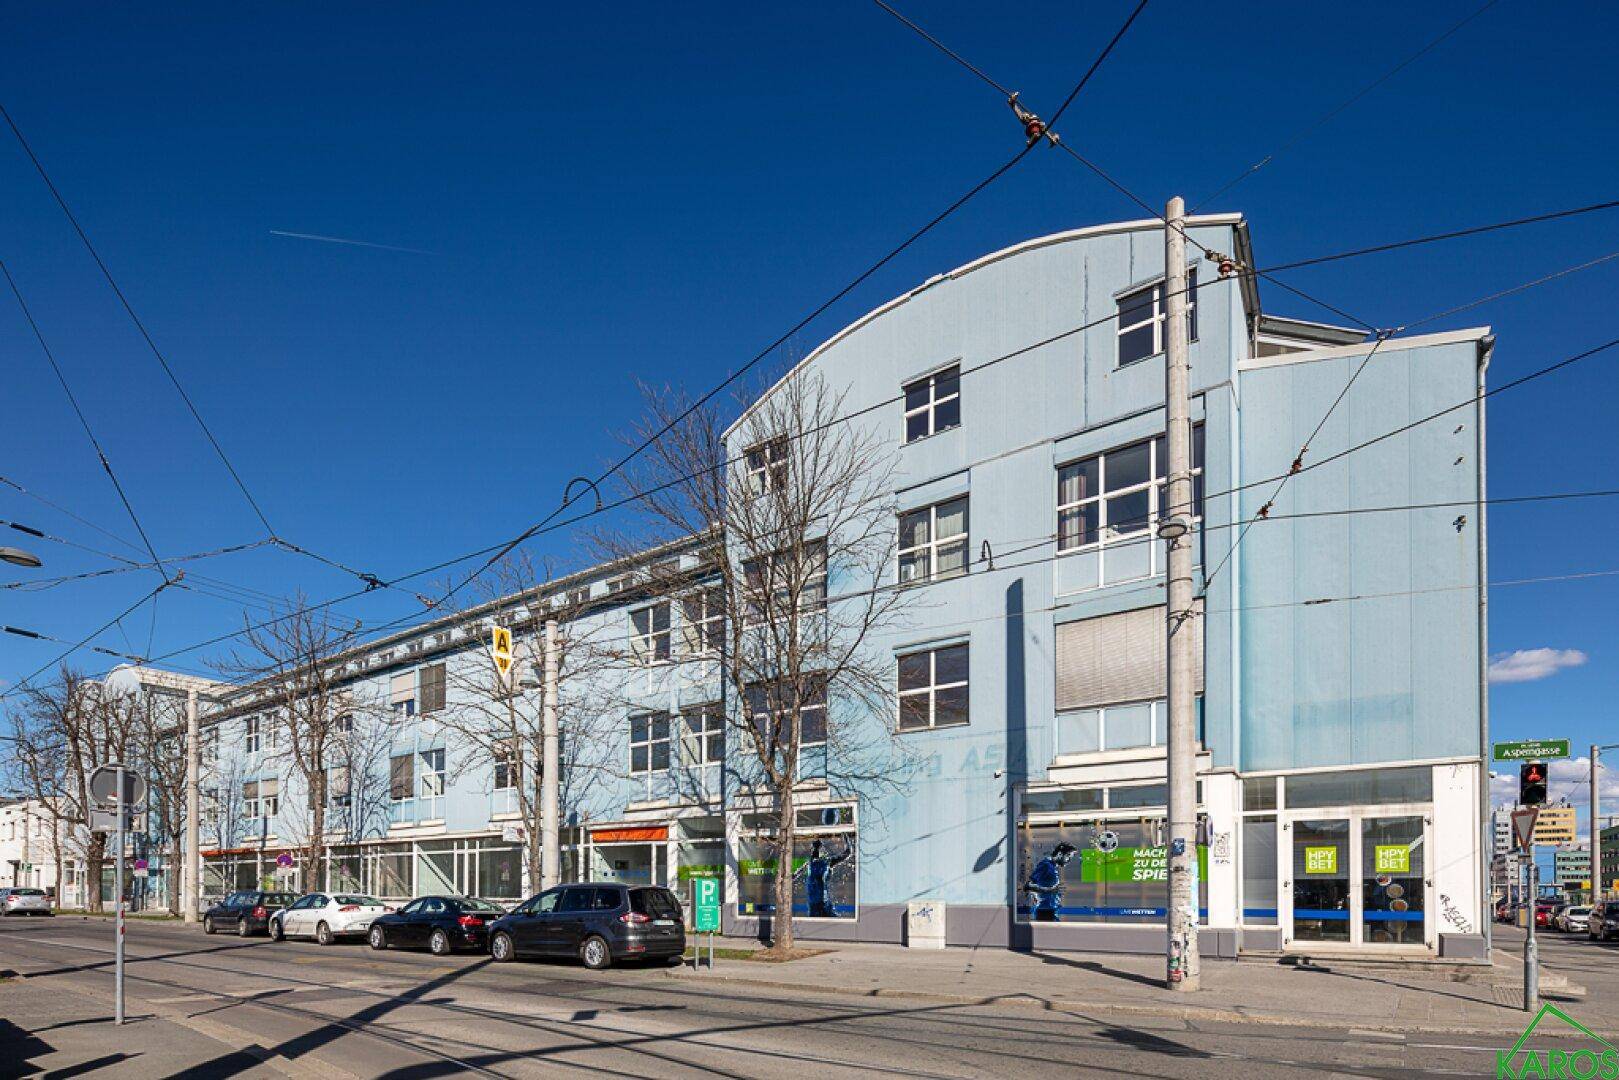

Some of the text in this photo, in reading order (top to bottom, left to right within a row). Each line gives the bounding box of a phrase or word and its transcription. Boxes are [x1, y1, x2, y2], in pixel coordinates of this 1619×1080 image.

[498, 632, 508, 652] A
[1133, 849, 1168, 857] MACH
[1308, 851, 1334, 860] HPY
[1379, 849, 1406, 858] HPY
[1133, 859, 1168, 867] ZU DE
[1308, 860, 1334, 870] BET
[1380, 859, 1406, 869] BET
[1132, 869, 1168, 880] SPIE
[702, 880, 716, 906] P
